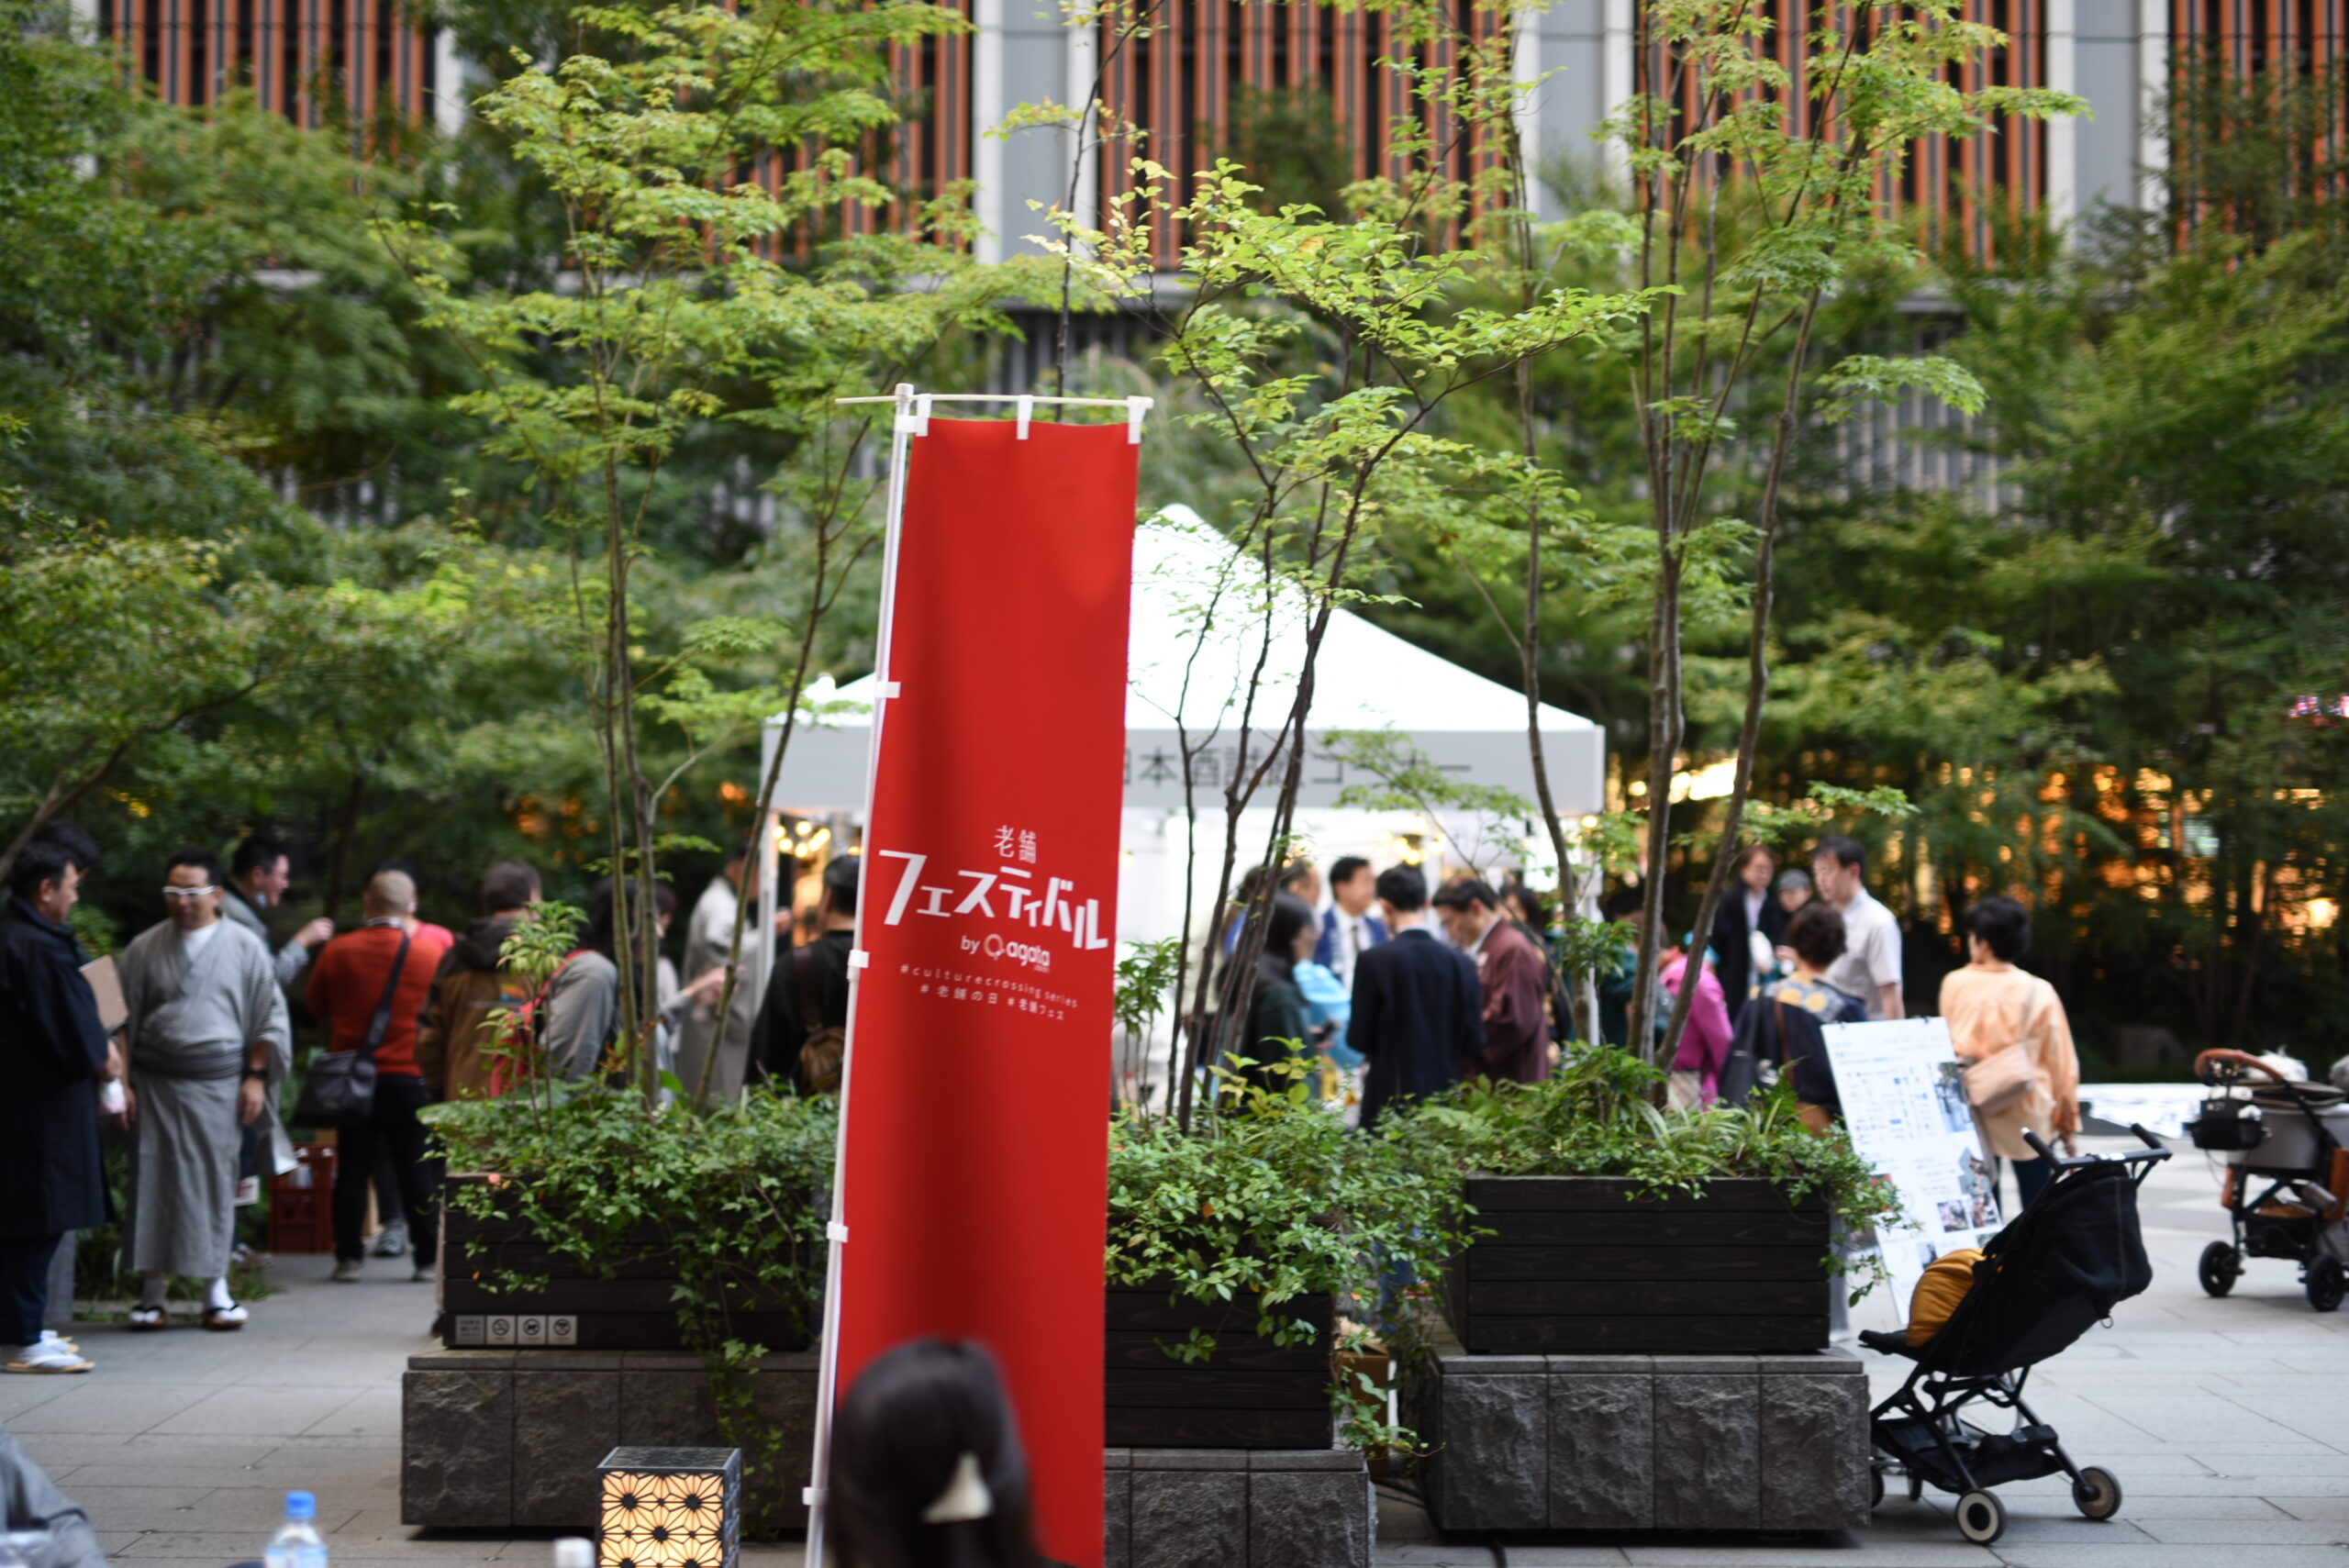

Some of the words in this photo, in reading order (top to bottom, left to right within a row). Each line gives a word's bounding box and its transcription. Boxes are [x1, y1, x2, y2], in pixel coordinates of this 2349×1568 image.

[994, 825, 1036, 864] 老舗
[878, 850, 1108, 951] フェスティバル
[961, 935, 980, 955] by
